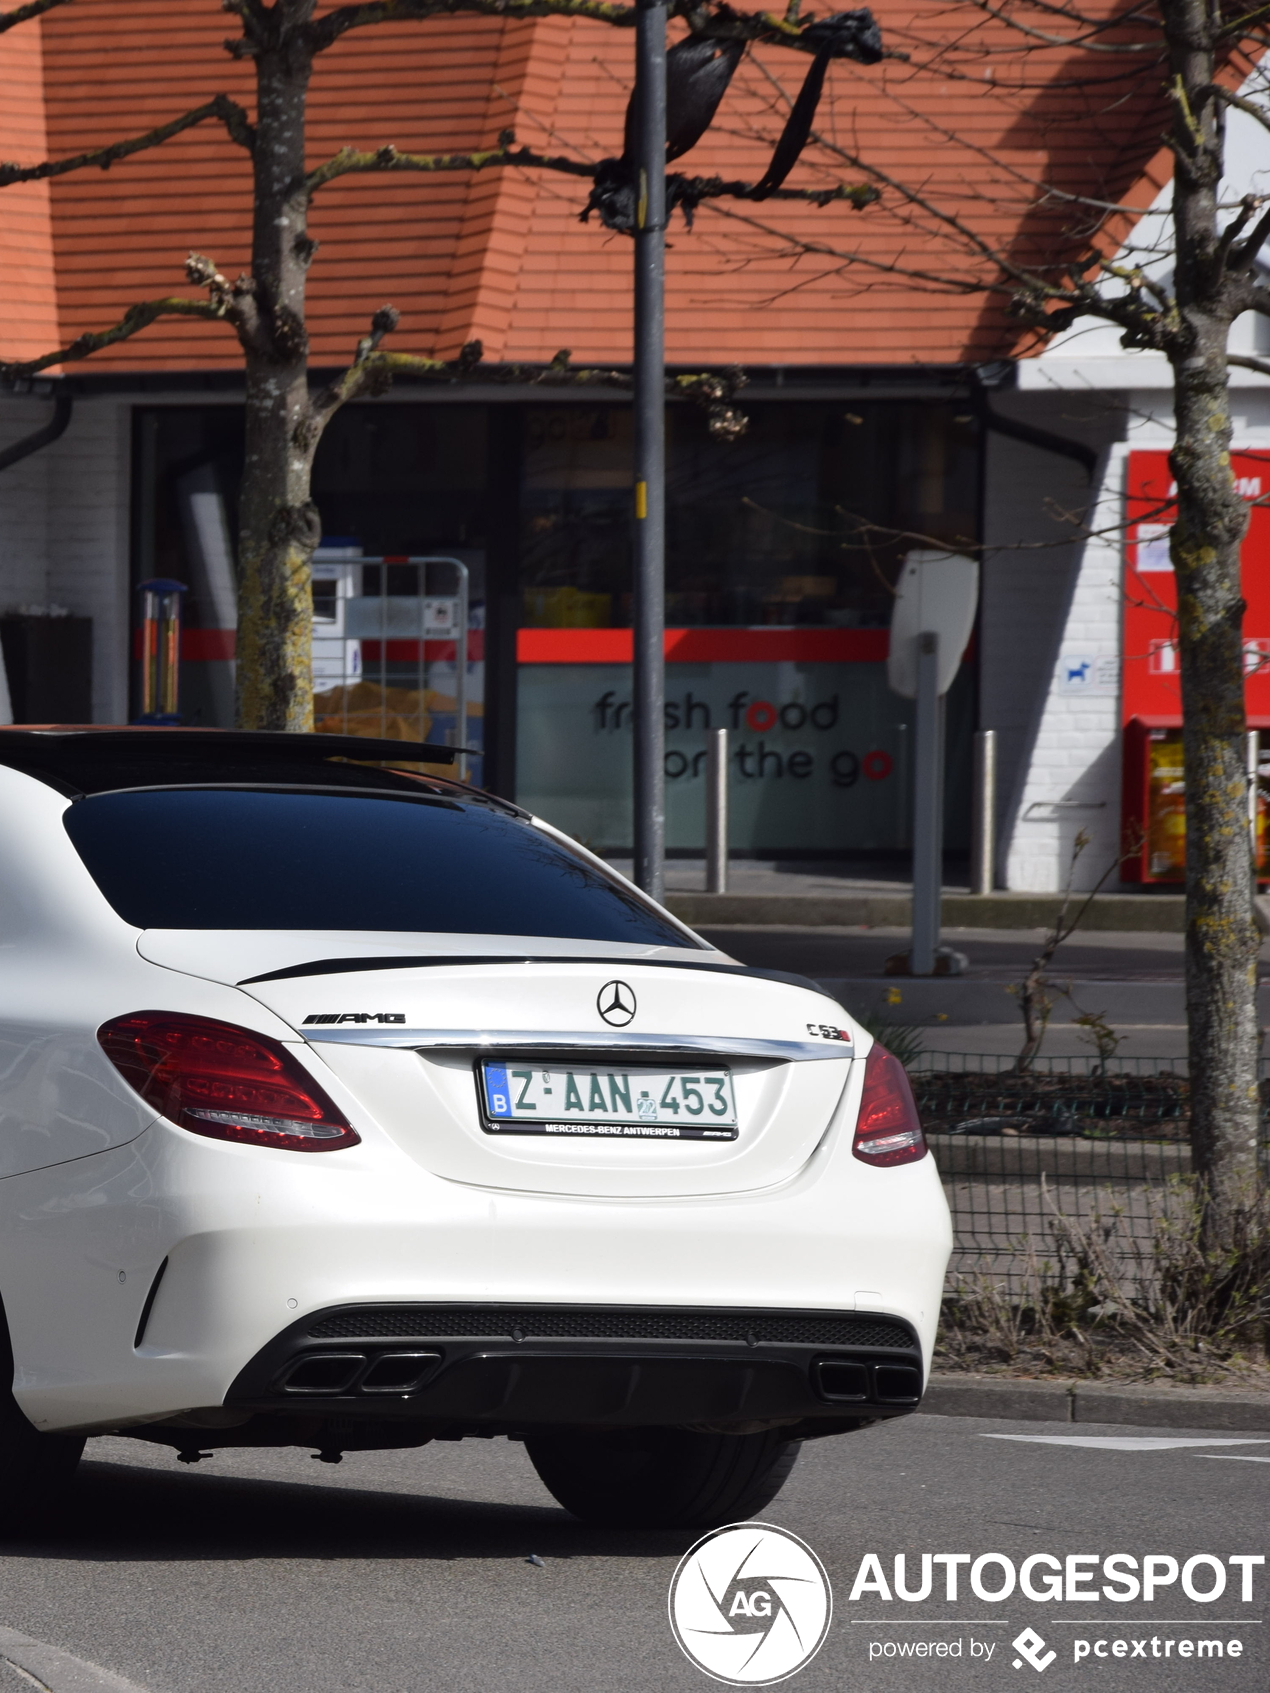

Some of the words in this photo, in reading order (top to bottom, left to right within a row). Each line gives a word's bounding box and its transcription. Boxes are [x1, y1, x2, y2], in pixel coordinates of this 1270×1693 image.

[595, 690, 711, 731] frsh
[728, 690, 840, 733] food
[734, 740, 814, 779] the
[830, 749, 894, 788] go
[334, 1013, 406, 1024] AMG
[493, 1094, 508, 1113] B
[511, 1070, 728, 1116] Z-AAN-453
[545, 1124, 622, 1135] MERCEDES-BENZ
[623, 1126, 680, 1137] ANTWERPEN
